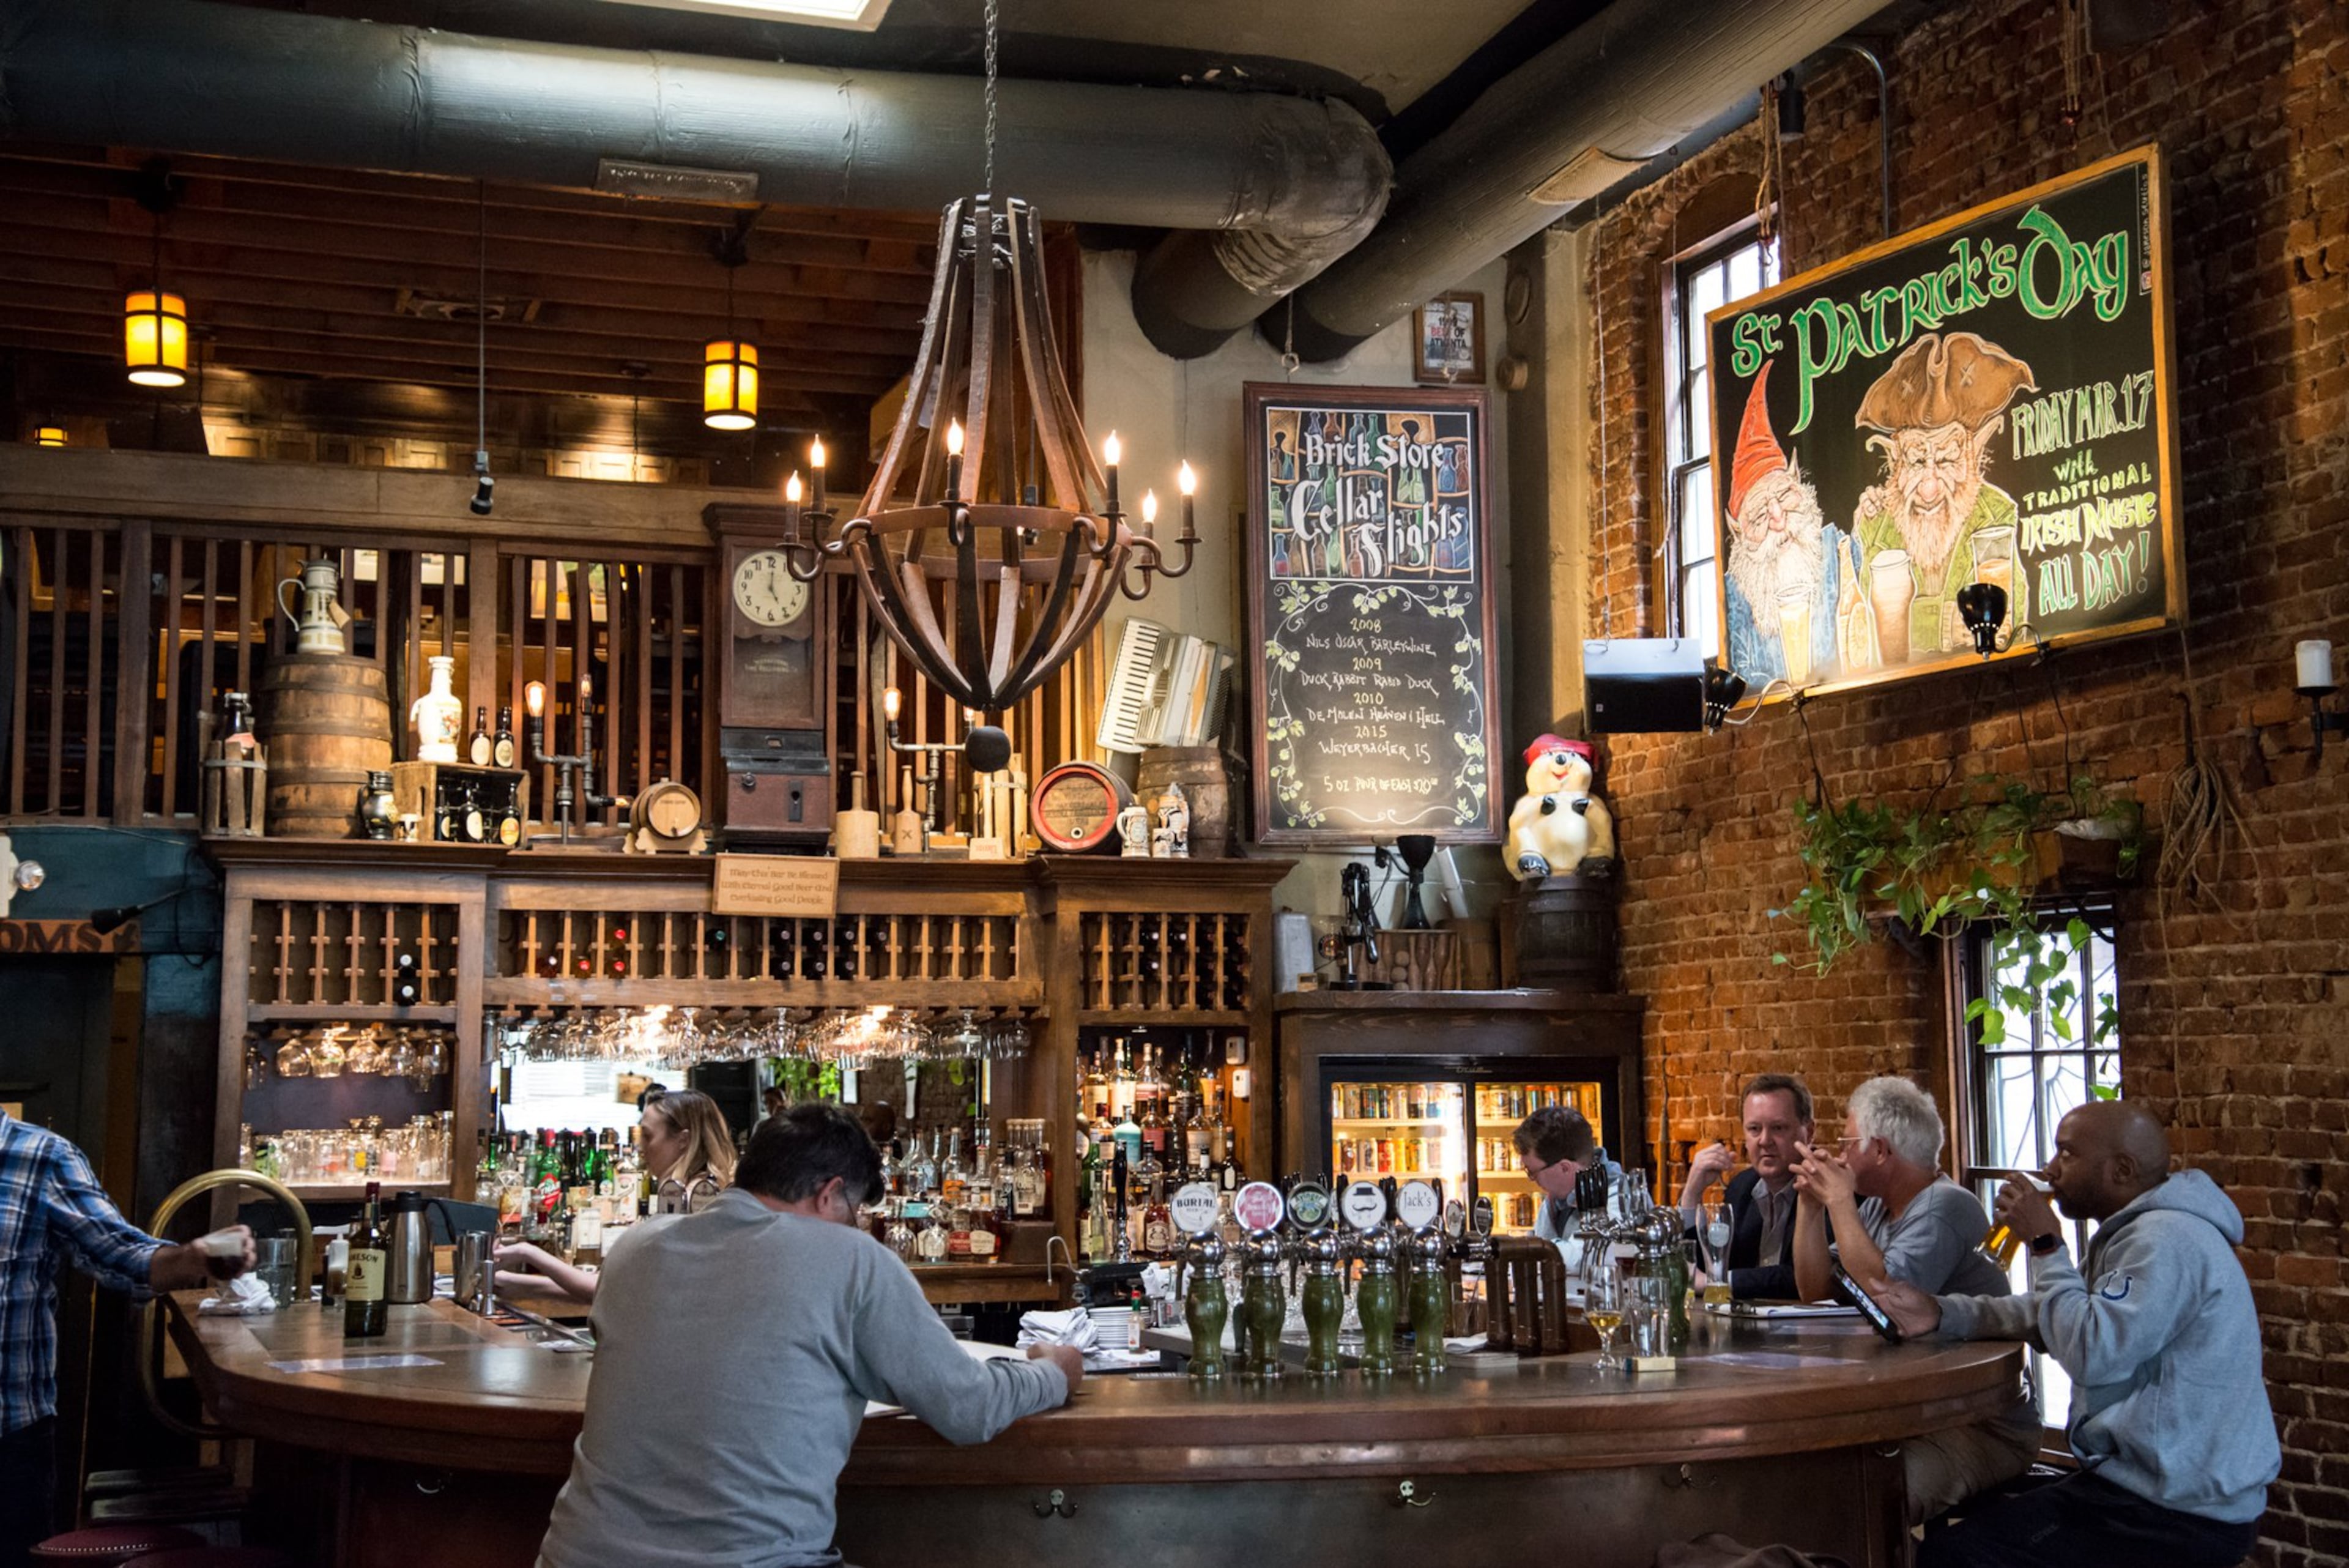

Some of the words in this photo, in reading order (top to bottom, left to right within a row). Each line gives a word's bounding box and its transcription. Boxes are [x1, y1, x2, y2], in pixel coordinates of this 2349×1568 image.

[2017, 204, 2129, 322] Day
[2011, 390, 2074, 461] FRIDAY
[2119, 370, 2154, 431] 17
[1304, 432, 1373, 467] Brick
[1374, 434, 1444, 469] Store
[2022, 462, 2152, 512] TRADITIONAL
[1291, 476, 1383, 541] Cellar
[2019, 503, 2084, 557] IRISH
[2081, 491, 2158, 552] MUSIC
[1354, 501, 1466, 577] Flights
[744, 569, 753, 580] 10
[2039, 552, 2078, 617] ALL
[2081, 531, 2150, 611] DAY!
[741, 583, 748, 593] 9
[795, 585, 801, 595] 3
[746, 596, 752, 606] 8
[755, 606, 760, 614] 7
[767, 610, 775, 622] 6
[1349, 618, 1382, 633] 2008
[1352, 657, 1382, 671] 2009
[1353, 692, 1384, 705] 2010
[1354, 726, 1388, 739] 2015
[1324, 776, 1334, 793] 5
[1403, 1191, 1433, 1209] Jack's
